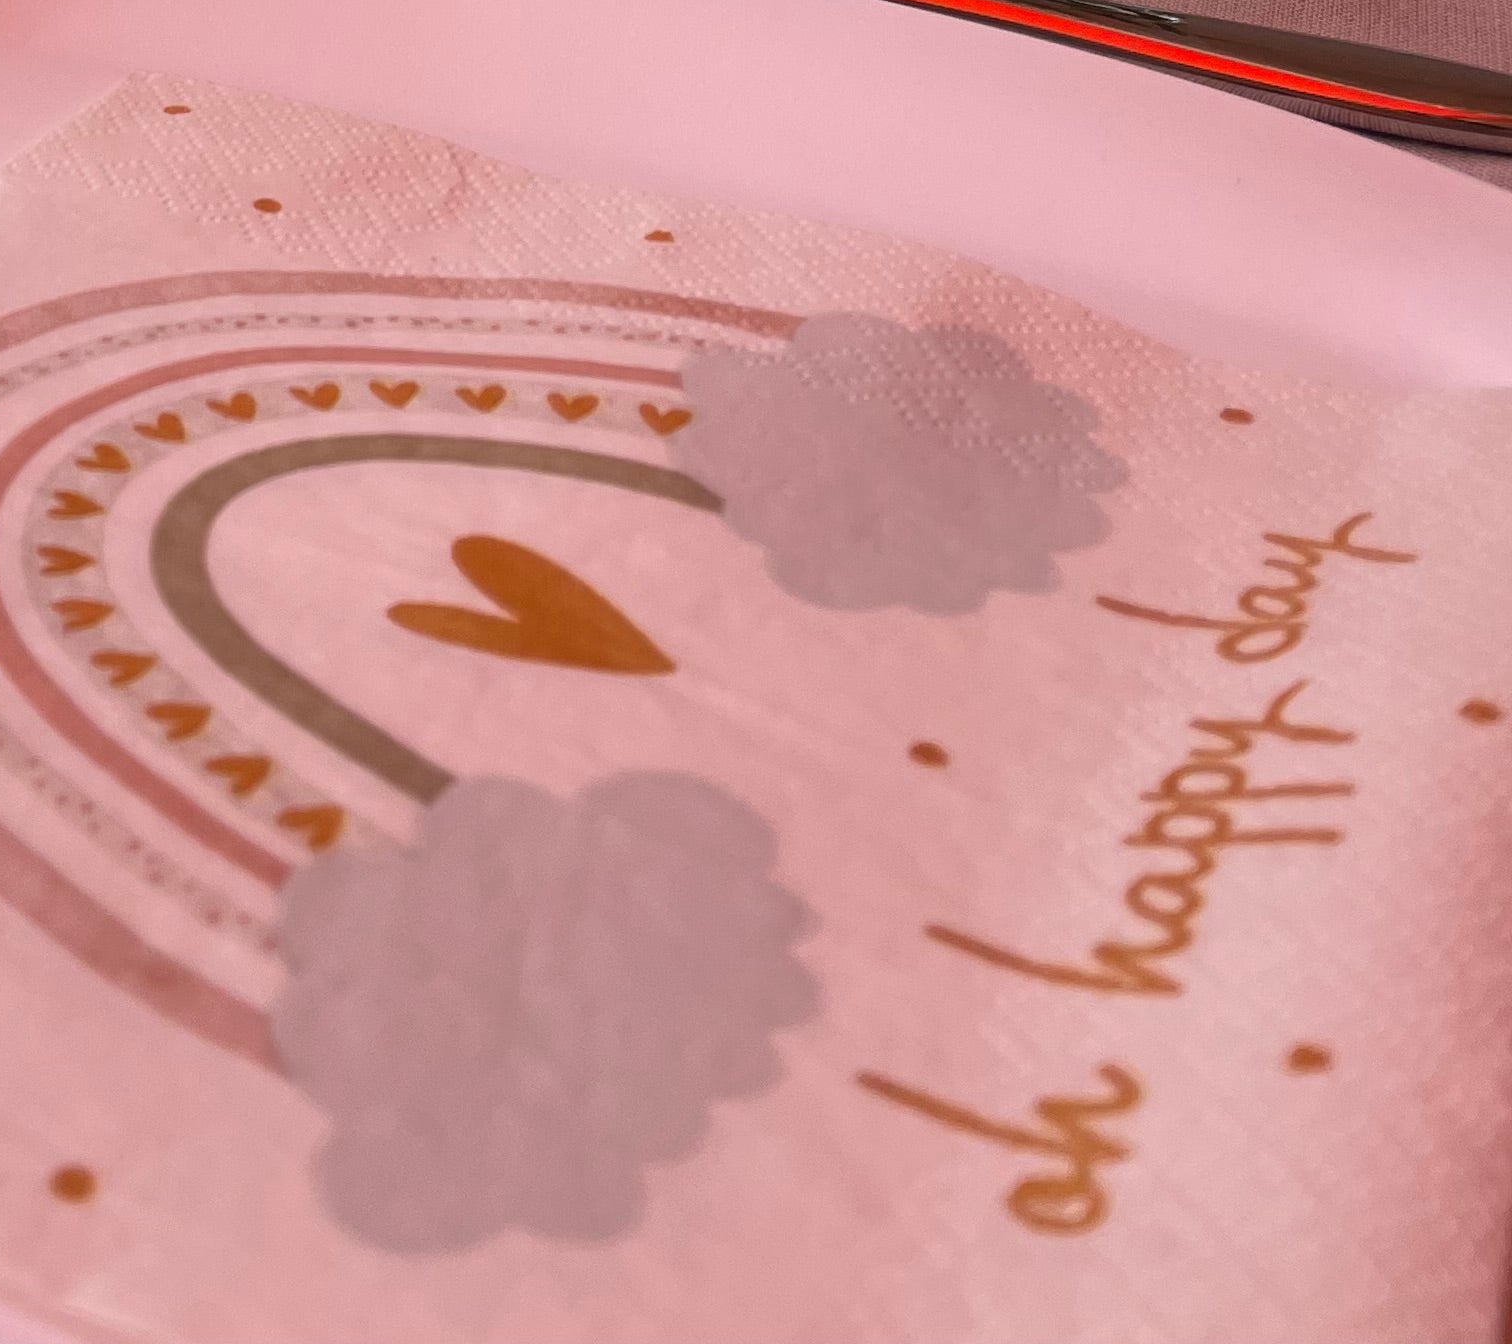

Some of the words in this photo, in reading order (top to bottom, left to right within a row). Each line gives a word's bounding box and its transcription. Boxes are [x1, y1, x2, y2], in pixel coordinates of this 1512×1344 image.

[1095, 511, 1420, 665] day
[923, 678, 1358, 997] happy
[855, 1063, 1147, 1236] oh
